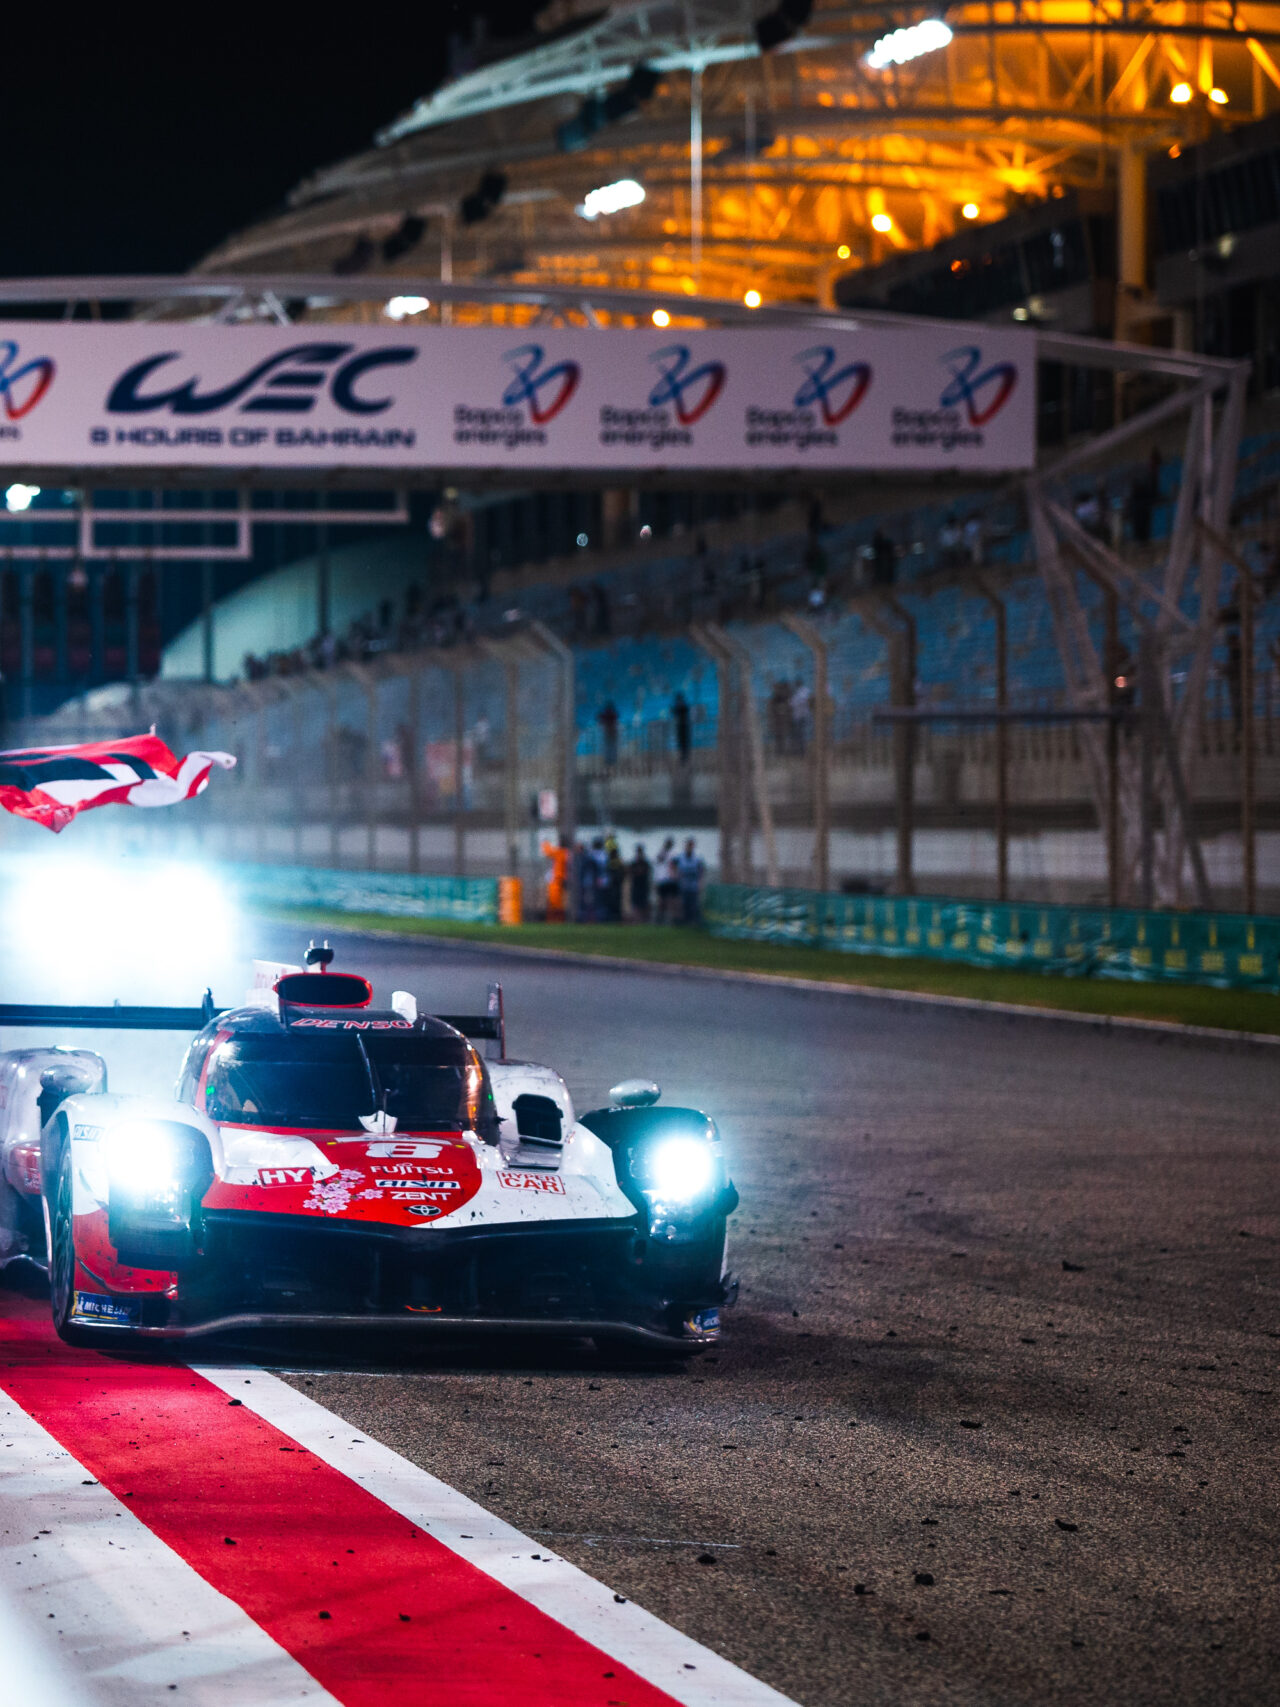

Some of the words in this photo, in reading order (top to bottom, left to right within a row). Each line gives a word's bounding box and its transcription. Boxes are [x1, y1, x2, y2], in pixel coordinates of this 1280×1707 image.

[106, 343, 418, 416] WEC
[117, 427, 222, 447] HOURS
[229, 427, 268, 447] OF
[275, 427, 417, 448] BAHRAIN
[453, 428, 547, 449] energies
[599, 428, 693, 449] energies
[745, 429, 839, 450] energies
[891, 429, 985, 450] energies
[291, 1017, 413, 1030] DENSO
[365, 1142, 443, 1158] 8
[261, 1169, 307, 1184] HY
[370, 1163, 454, 1175] FUJITSU
[501, 1172, 557, 1182] HYPER
[504, 1178, 560, 1192] CAR
[390, 1191, 451, 1201] ZENT
